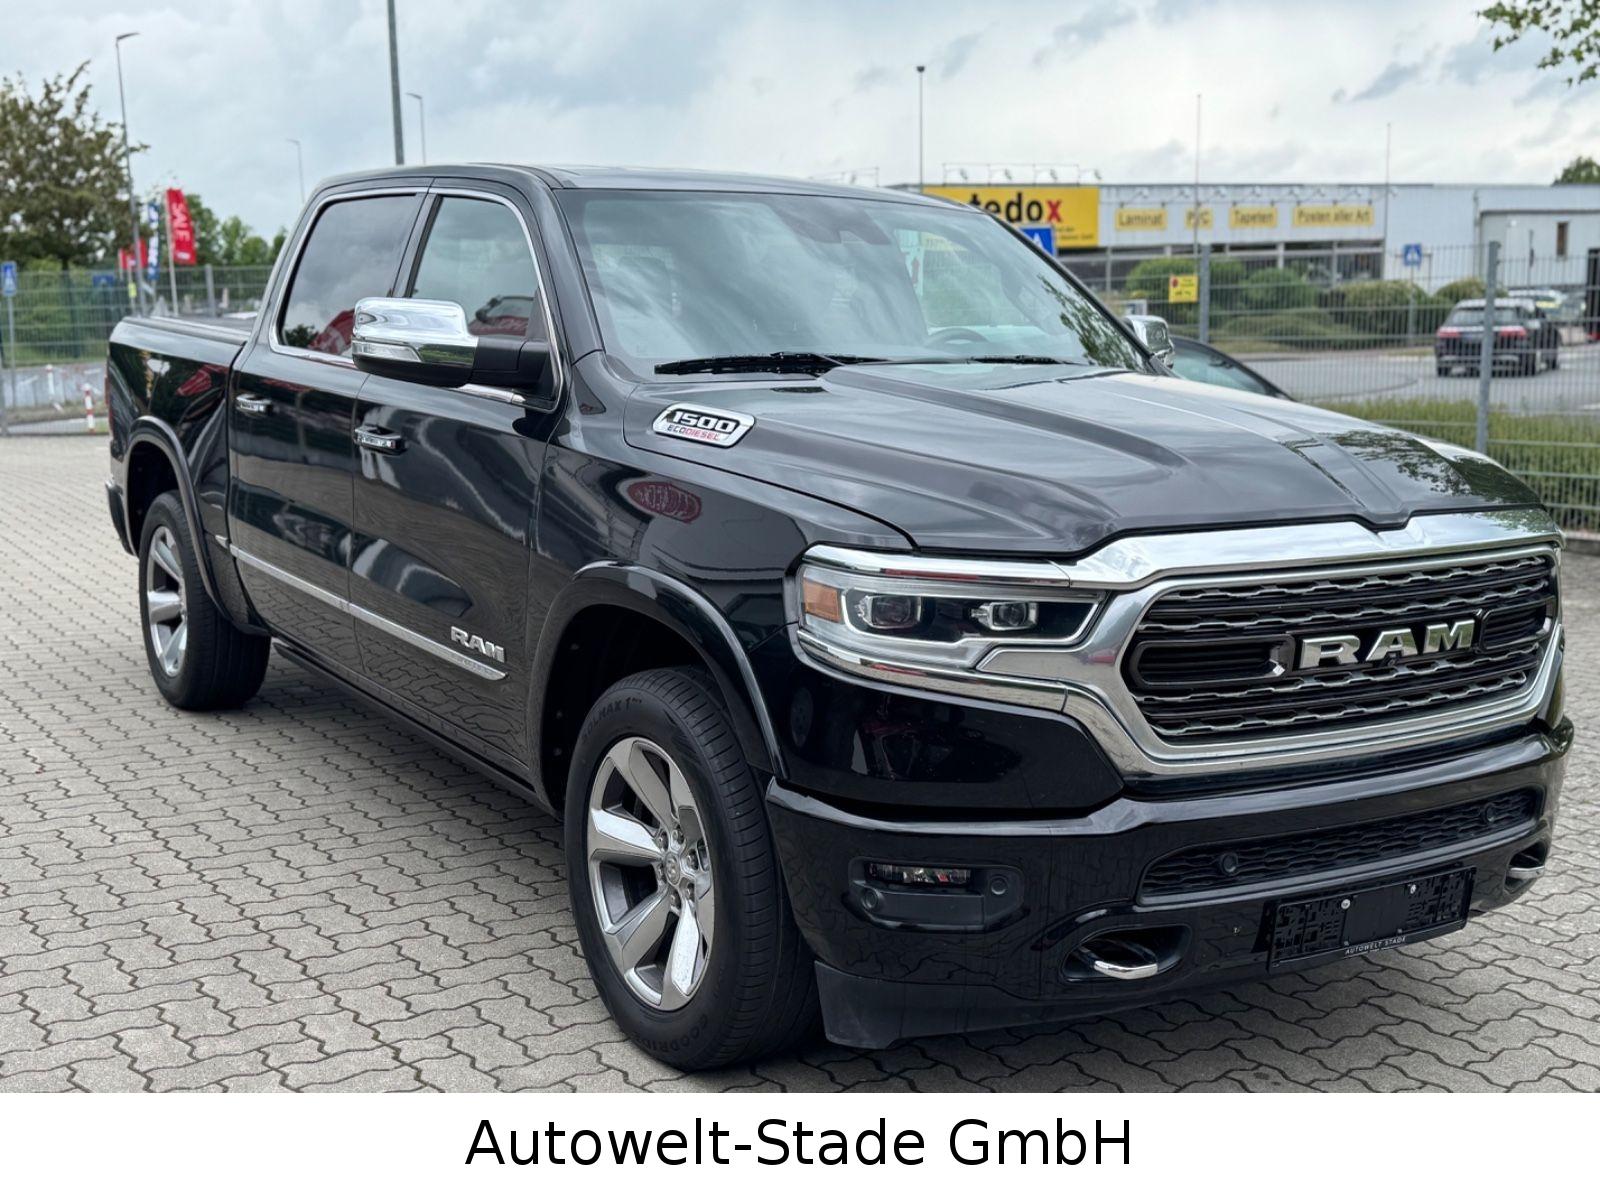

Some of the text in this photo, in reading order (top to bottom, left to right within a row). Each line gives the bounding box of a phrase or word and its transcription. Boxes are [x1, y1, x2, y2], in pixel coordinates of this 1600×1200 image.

[1118, 210, 1163, 226] Laminat
[1234, 209, 1274, 225] Tapeten
[673, 410, 737, 433] 1500
[667, 424, 721, 442] ECODIESEL
[450, 626, 505, 663] RAM
[1300, 619, 1475, 668] RAM
[1345, 941, 1382, 955] AUTOWELT
